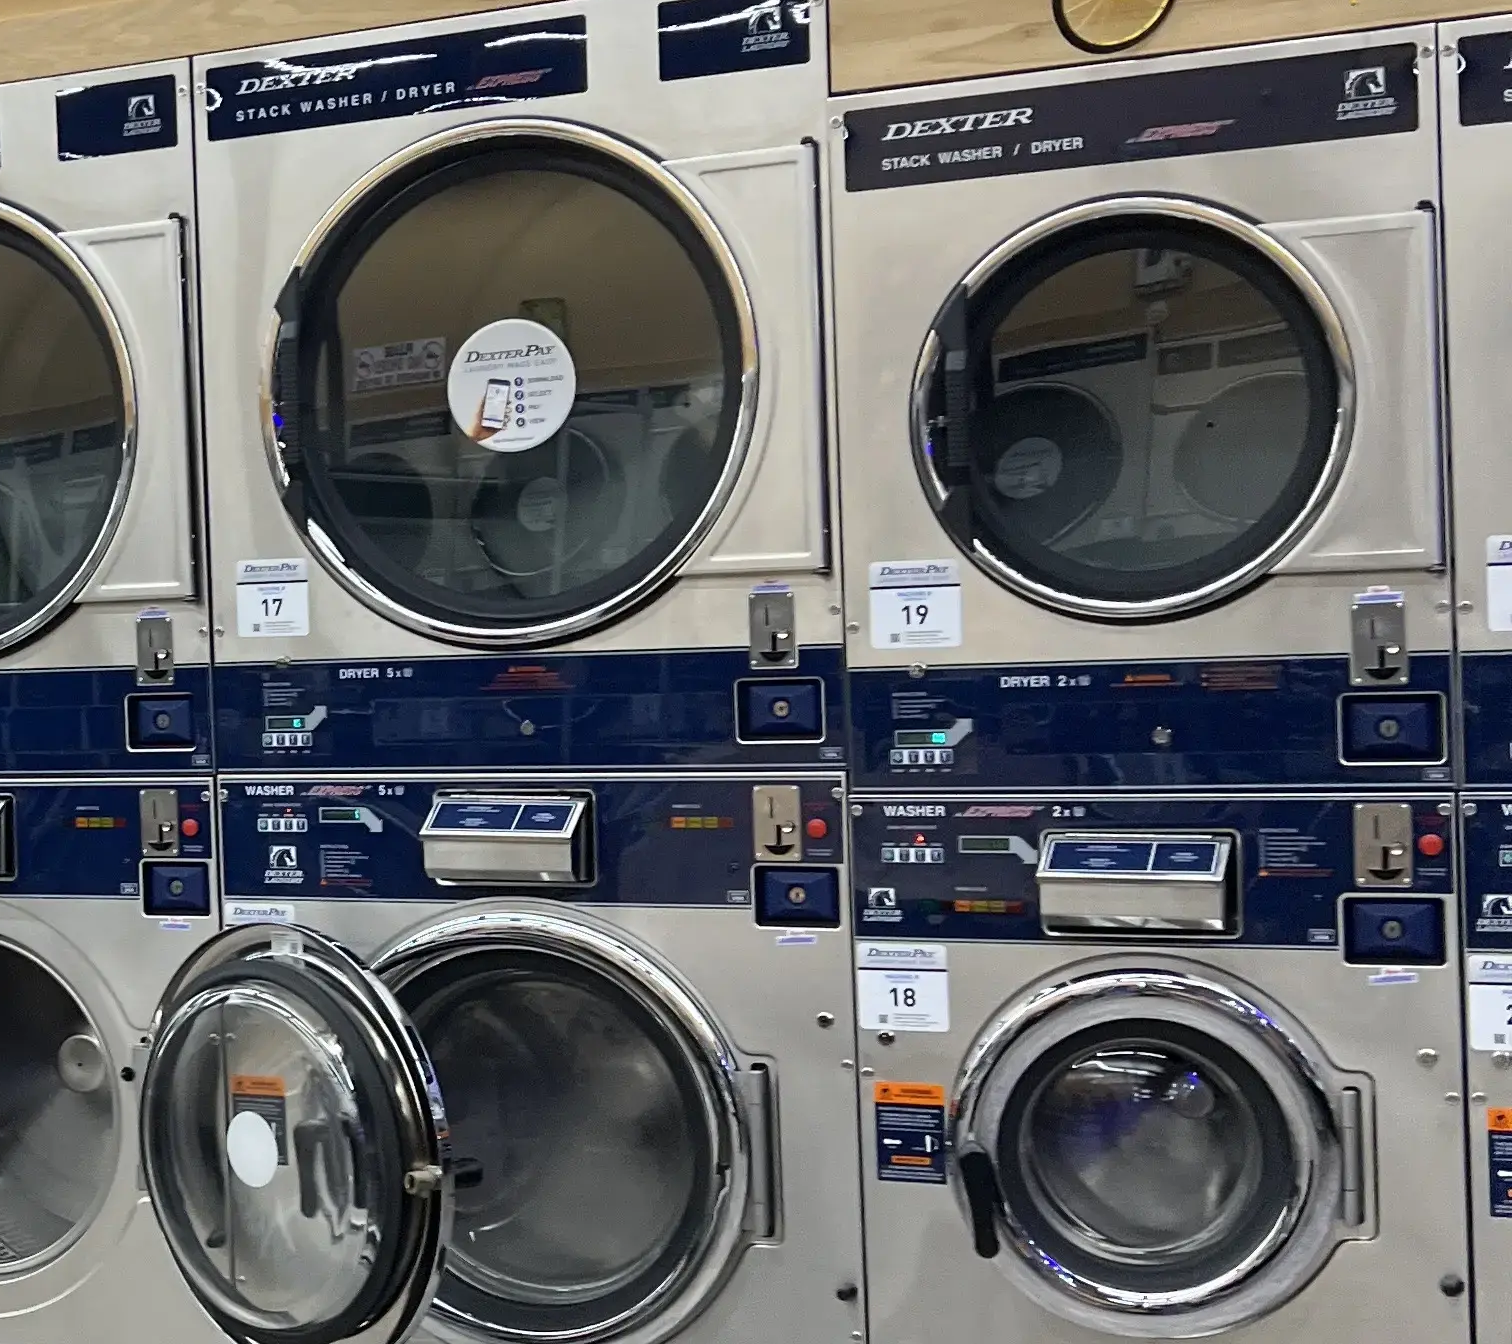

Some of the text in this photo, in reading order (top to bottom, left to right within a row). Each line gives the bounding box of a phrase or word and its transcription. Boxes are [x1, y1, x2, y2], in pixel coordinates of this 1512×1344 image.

[236, 66, 358, 96] DEXTER
[236, 103, 291, 122] STACK
[300, 93, 372, 113] WASHER
[396, 82, 456, 101] DRYER
[881, 107, 1034, 142] DEXTER
[881, 154, 931, 171] STACK
[938, 146, 1003, 164] WASHER
[1031, 137, 1084, 154] DRYER
[261, 598, 283, 617] 17
[901, 604, 929, 625] 19
[339, 668, 379, 679] DRYER
[999, 675, 1051, 688] DRYER
[245, 785, 294, 796] WASHER
[883, 805, 946, 817] WASHER
[889, 987, 917, 1008] 18
